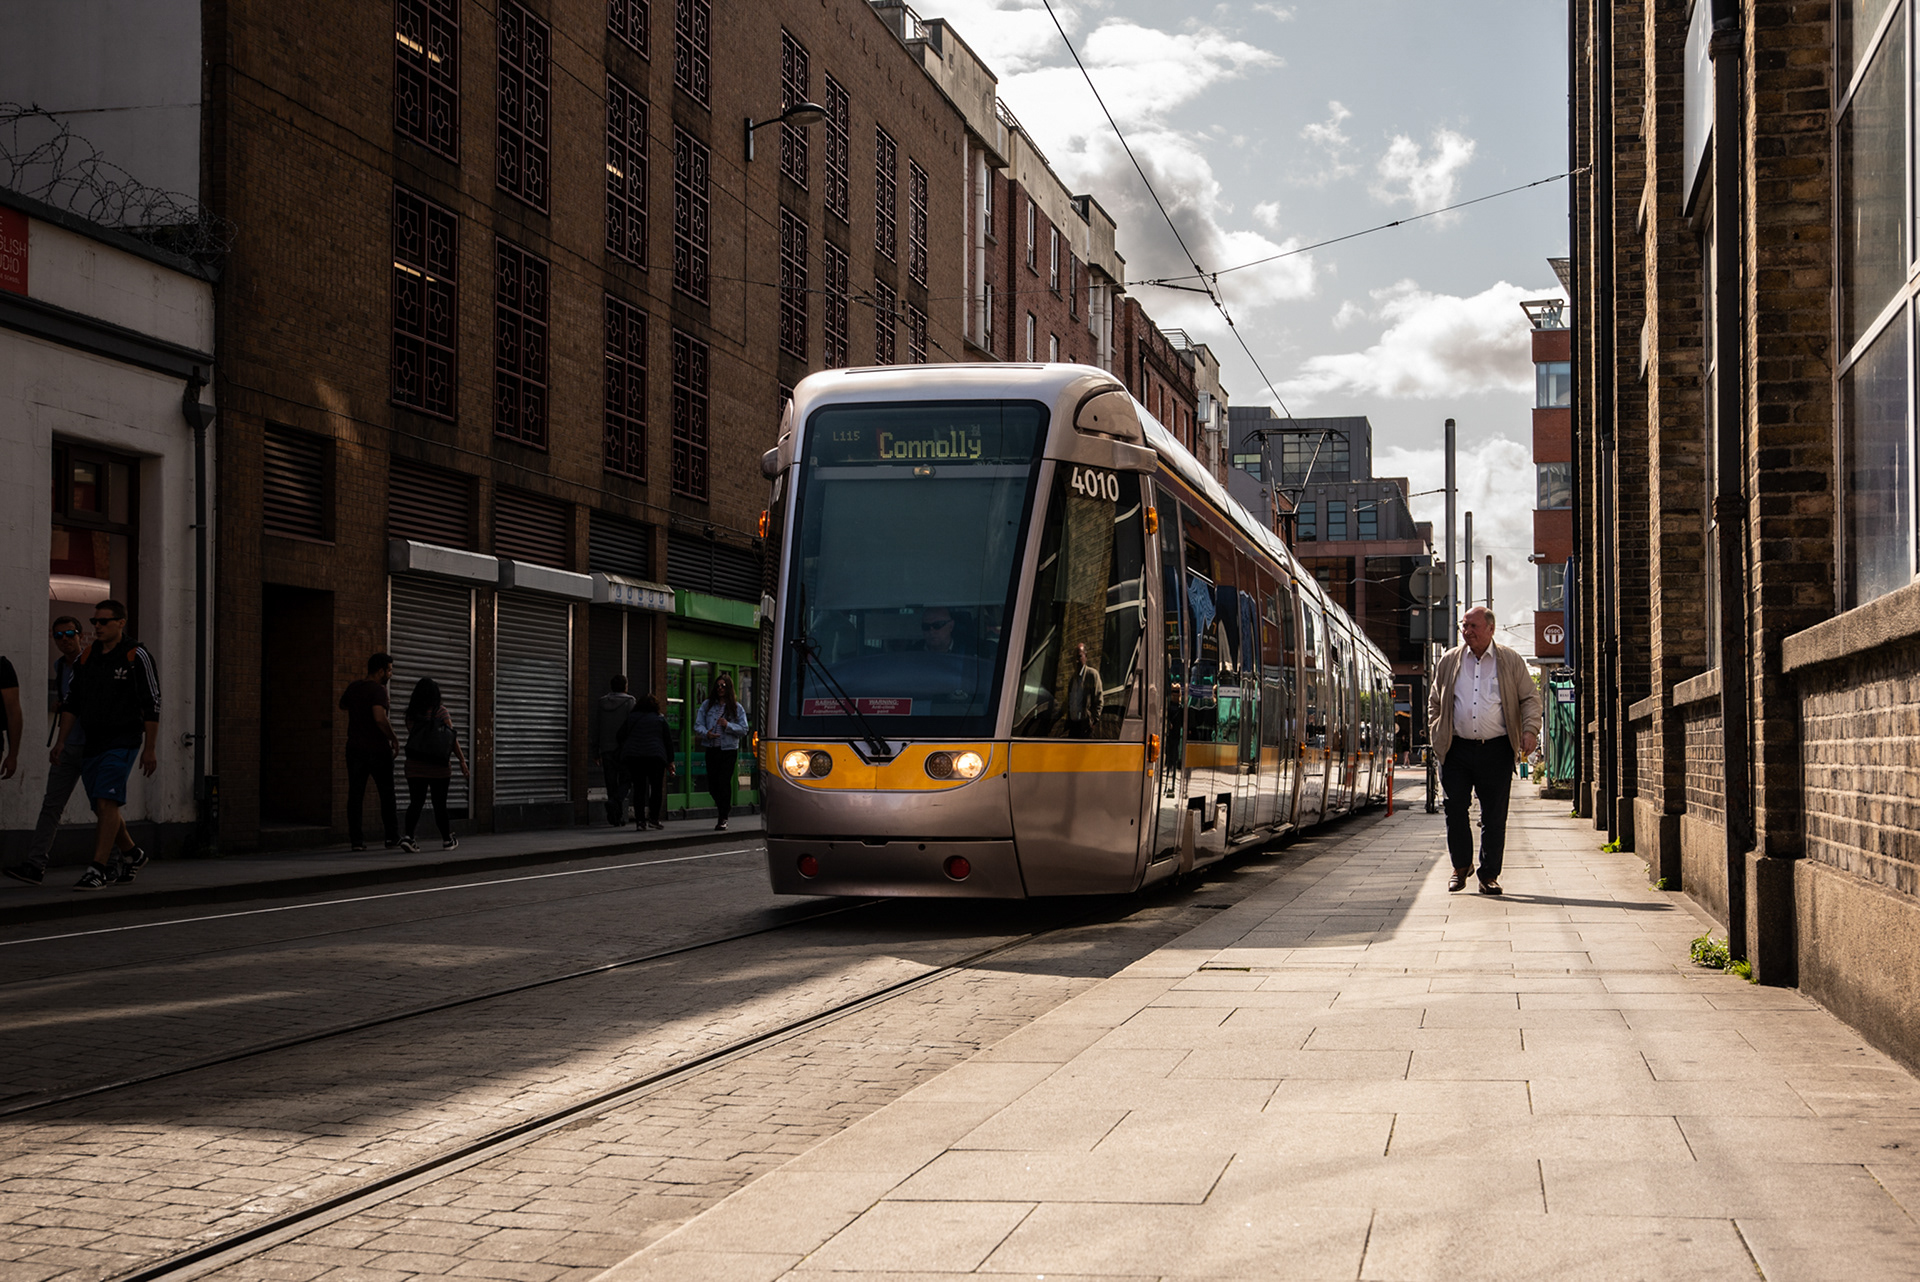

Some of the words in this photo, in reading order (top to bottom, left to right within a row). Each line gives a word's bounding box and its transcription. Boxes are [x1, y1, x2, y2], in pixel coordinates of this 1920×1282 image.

[832, 431, 861, 442] L115
[879, 430, 982, 459] Connolly
[1071, 466, 1120, 503] 4010
